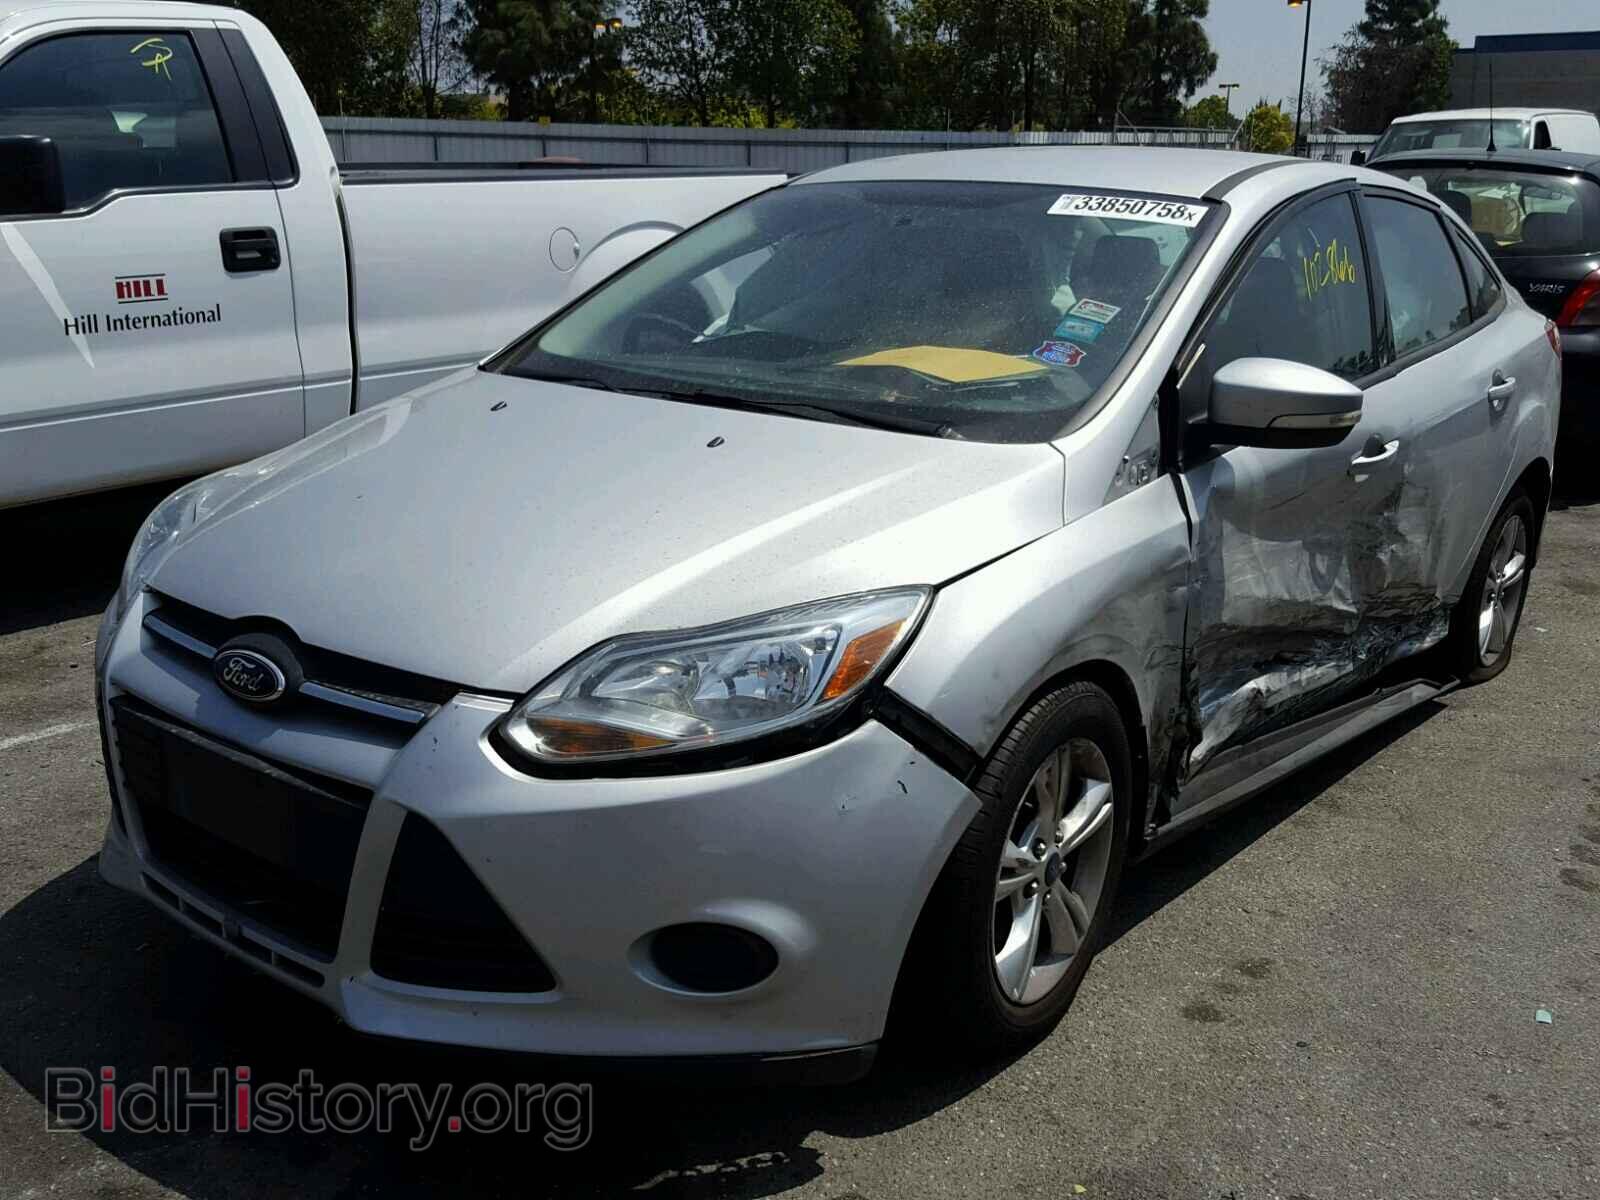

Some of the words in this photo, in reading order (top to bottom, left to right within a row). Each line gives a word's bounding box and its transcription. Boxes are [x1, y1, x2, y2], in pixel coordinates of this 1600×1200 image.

[115, 278, 168, 299] HILL
[1528, 282, 1567, 294] YARIS
[63, 313, 99, 336] Hill
[106, 303, 222, 333] International
[223, 657, 265, 692] Ford
